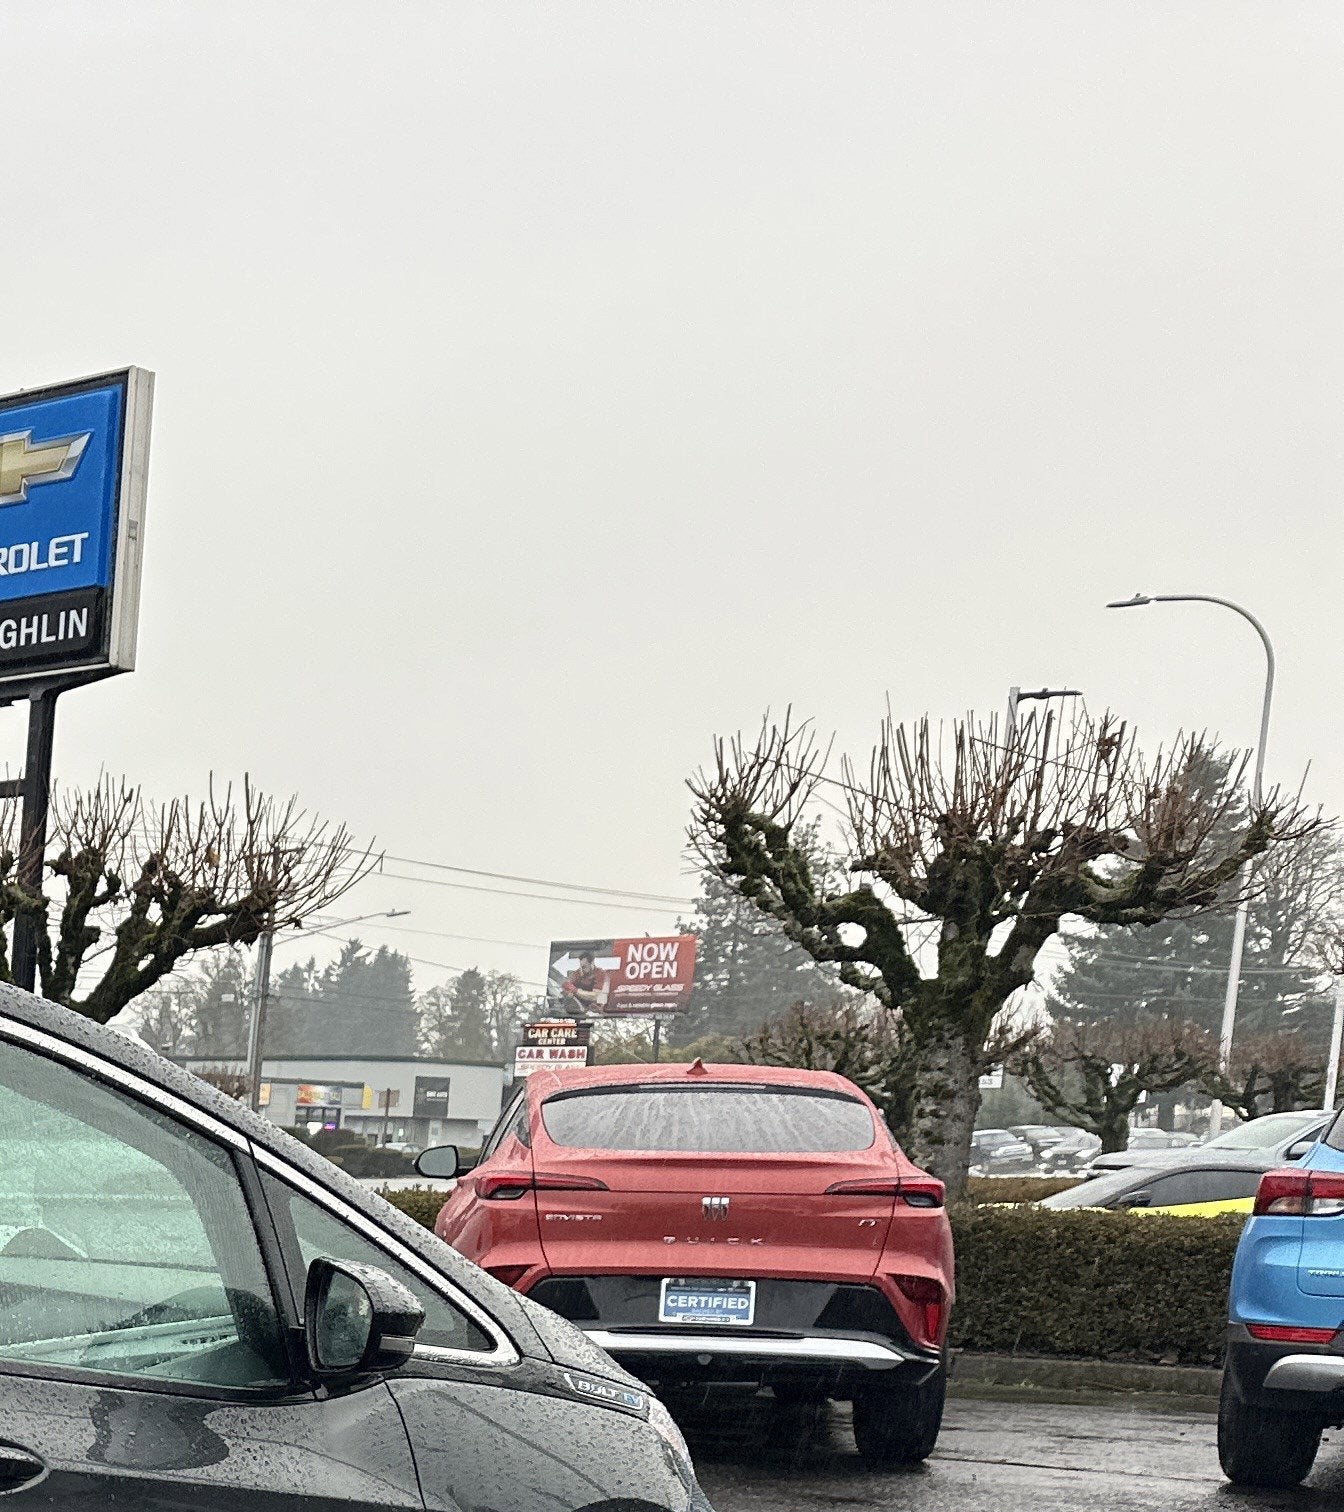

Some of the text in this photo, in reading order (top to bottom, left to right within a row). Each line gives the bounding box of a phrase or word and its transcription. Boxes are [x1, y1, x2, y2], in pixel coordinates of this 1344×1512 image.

[627, 942, 679, 962] NOW
[624, 961, 678, 979] OPEN
[528, 1028, 578, 1038] CAR CARE
[517, 1049, 586, 1059] CAR WASH
[667, 1295, 750, 1310] CERTIFIED
